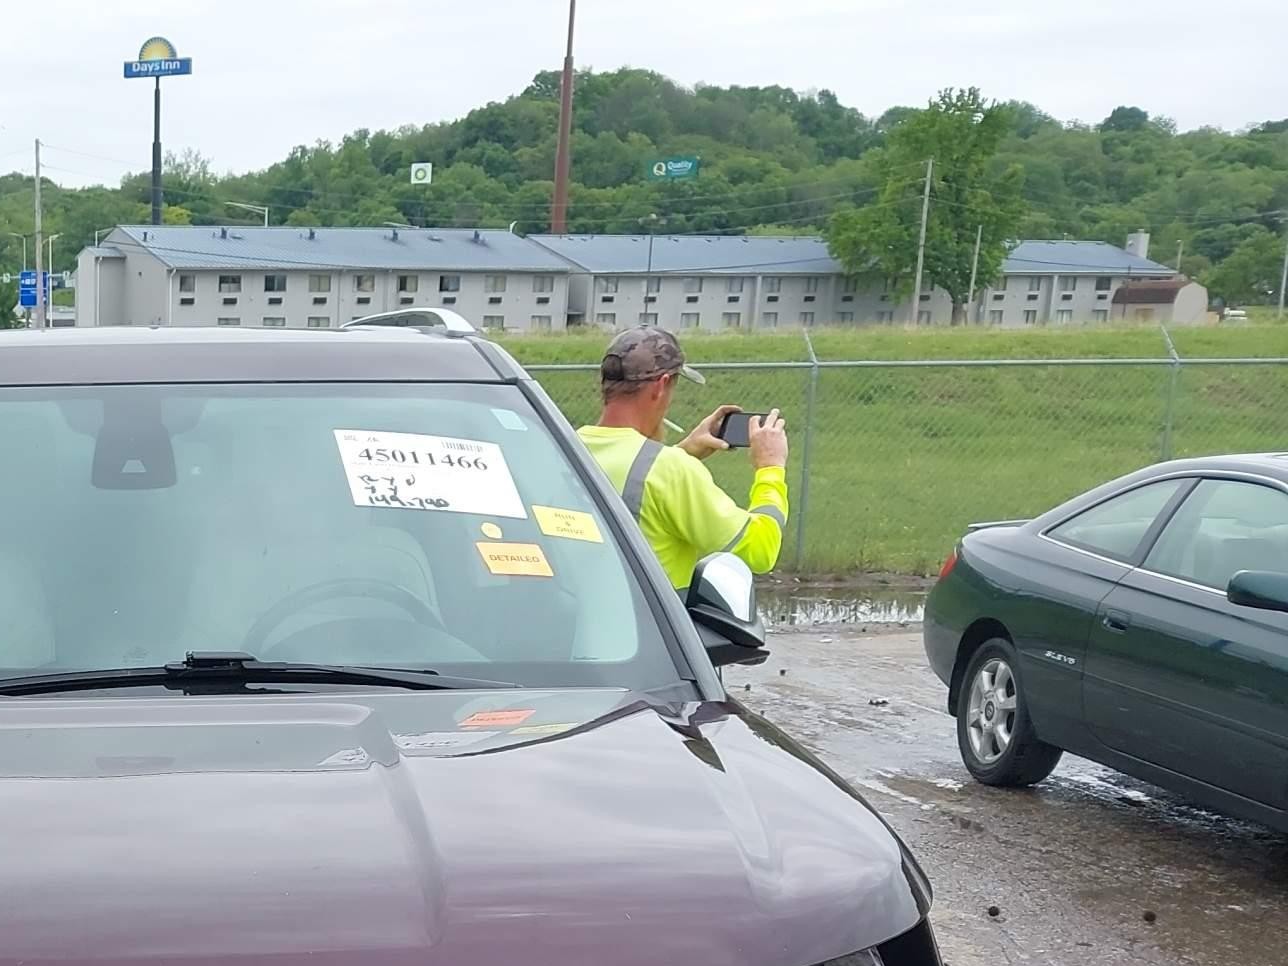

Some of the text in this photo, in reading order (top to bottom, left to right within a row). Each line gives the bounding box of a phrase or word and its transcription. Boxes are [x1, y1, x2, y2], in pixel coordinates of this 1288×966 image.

[132, 62, 160, 73] Days
[161, 59, 180, 70] Inn
[358, 447, 488, 471] 45011466
[488, 554, 540, 563] DETAILED
